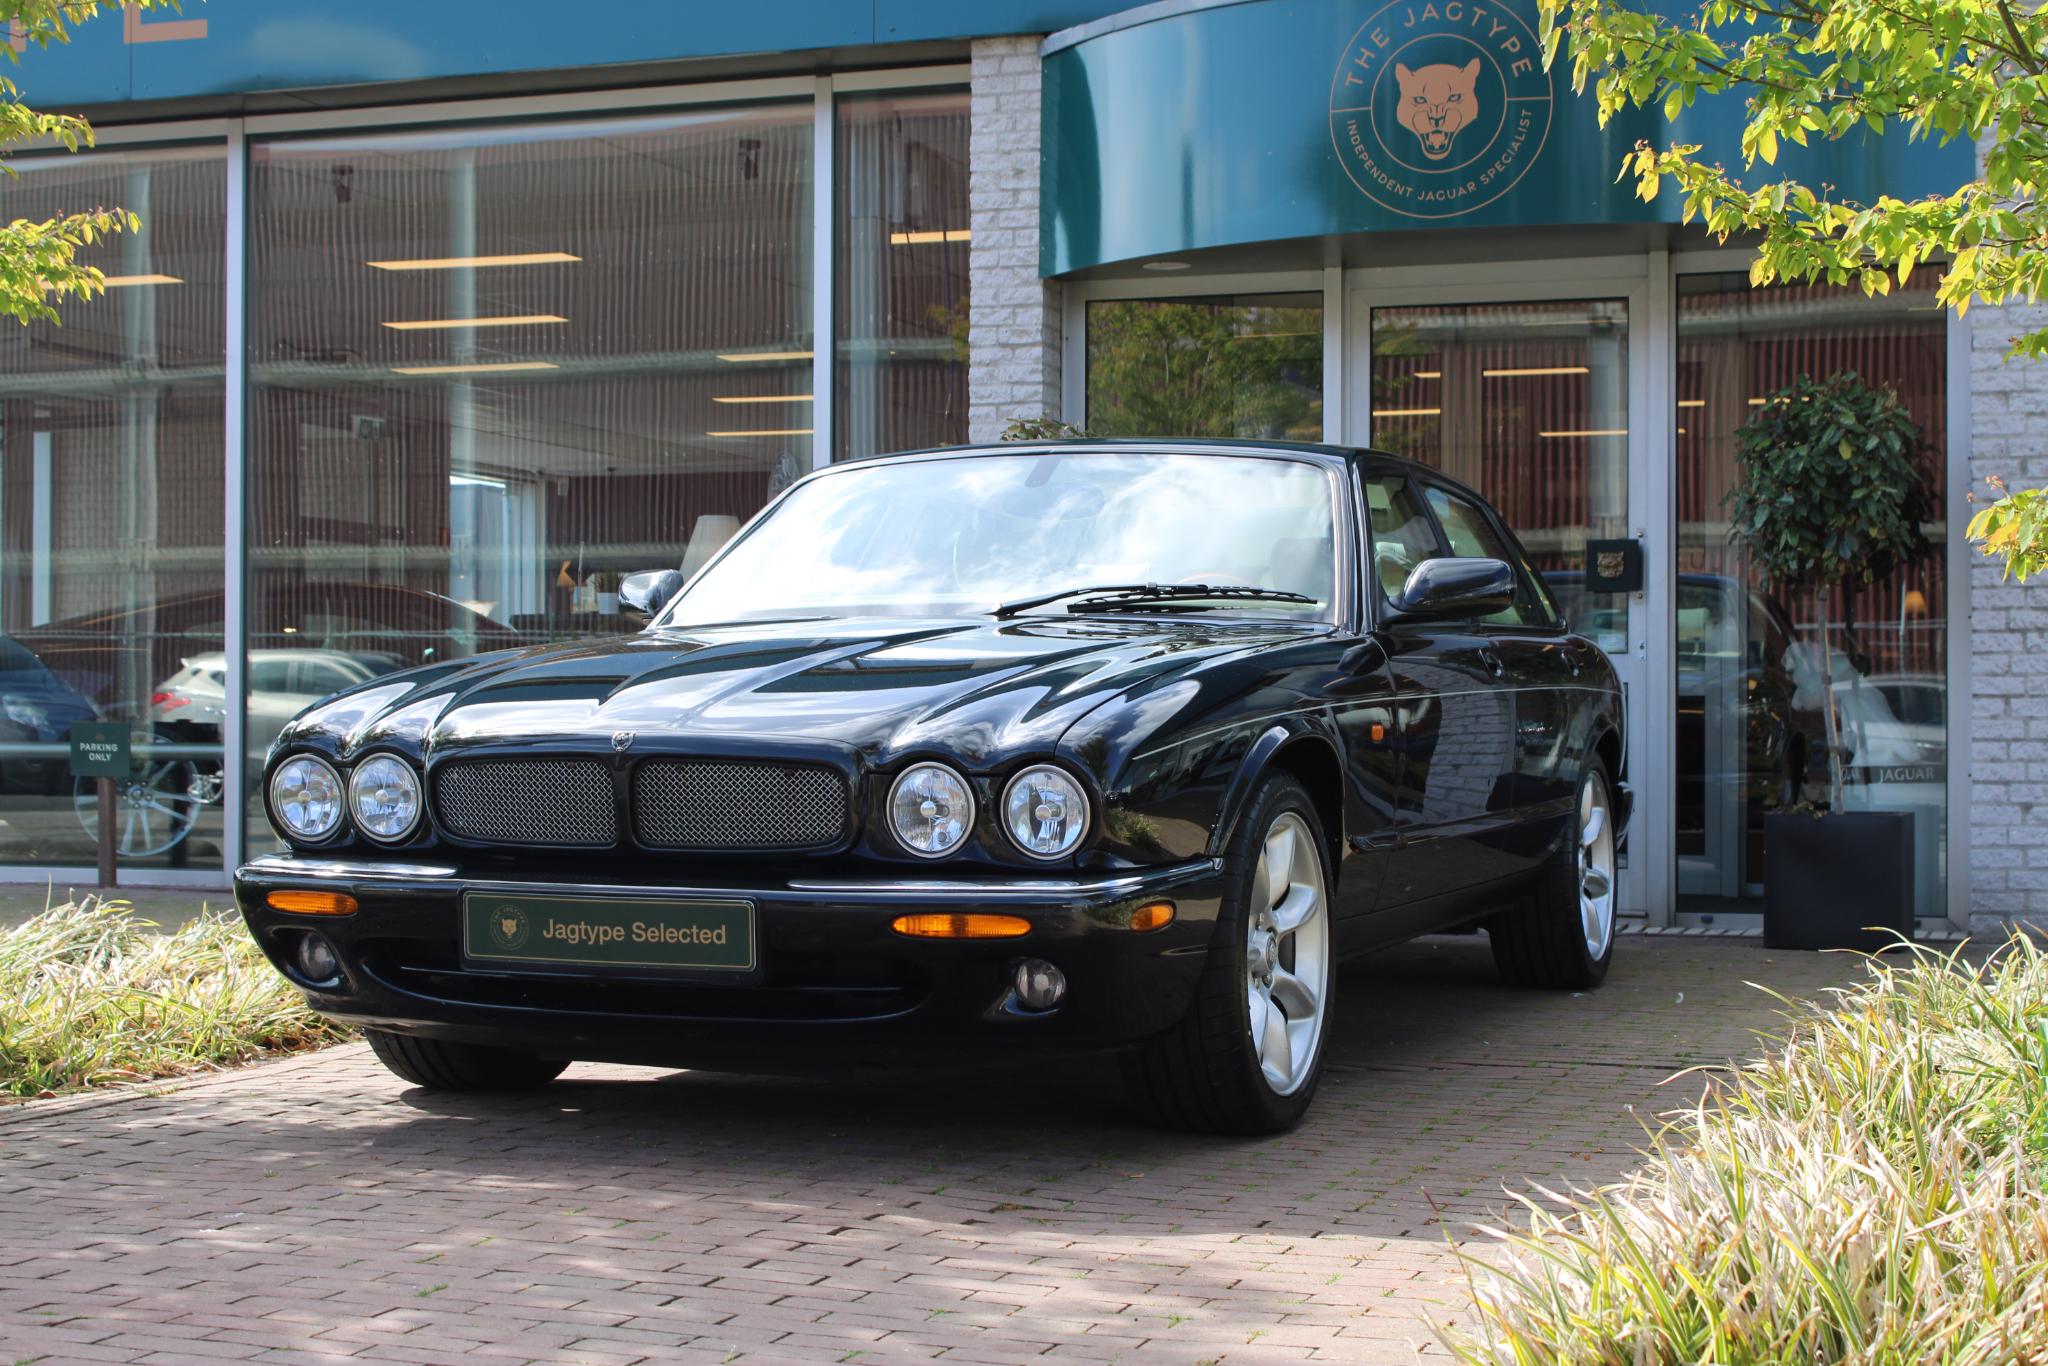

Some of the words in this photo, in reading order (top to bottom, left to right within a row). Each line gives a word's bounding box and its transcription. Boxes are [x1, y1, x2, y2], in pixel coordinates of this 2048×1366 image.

[1345, 28, 1390, 87] THE
[1404, 3, 1532, 77] JAGTYPE
[1347, 120, 1413, 197] INDEPENDENT
[1418, 182, 1476, 201] JAGUAR
[1480, 109, 1532, 185] SPECIALIST
[80, 743, 118, 752] PARKING
[89, 752, 111, 761] ONLY
[1880, 768, 1934, 784] JAGUAR
[544, 919, 625, 944] Jagtype
[632, 922, 726, 944] Selected
